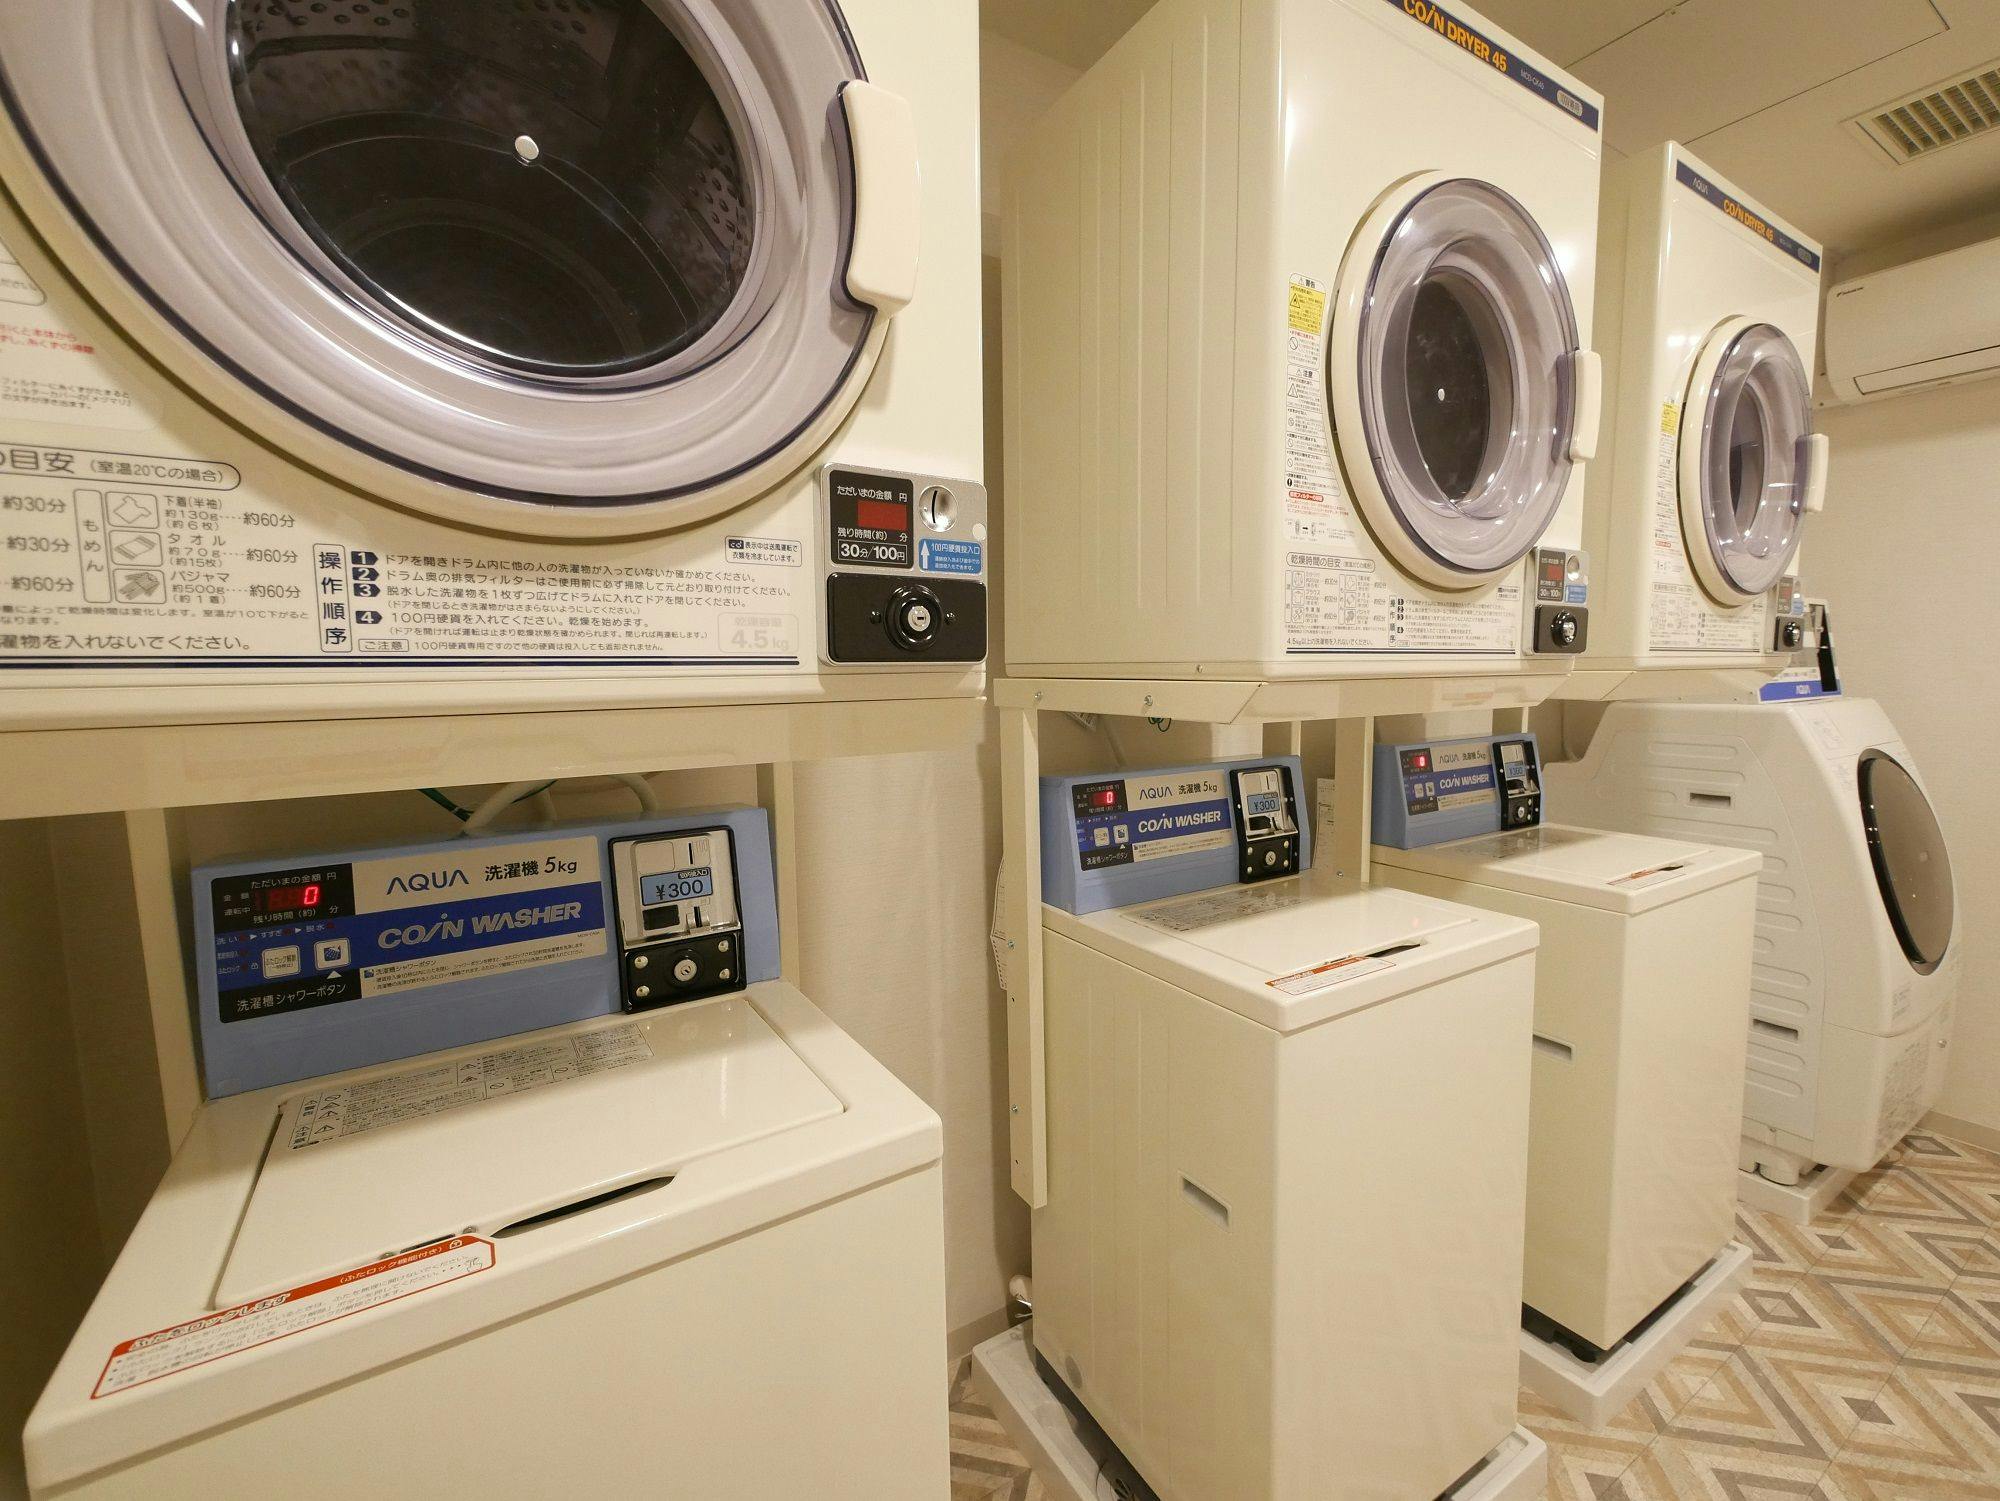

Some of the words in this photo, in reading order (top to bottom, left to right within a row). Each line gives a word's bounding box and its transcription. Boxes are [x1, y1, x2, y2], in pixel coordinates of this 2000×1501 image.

[1447, 20, 1490, 62] DRYER
[1492, 54, 1508, 73] 45
[1744, 213, 1766, 236] DRYER
[0, 449, 74, 474] 目安
[836, 485, 893, 502] ただいまの金額
[898, 492, 908, 503] 円
[3, 496, 67, 513] 約30分
[243, 512, 295, 528] 約60分
[837, 527, 888, 541] 残り時間(約)
[898, 533, 909, 543] 分
[7, 536, 70, 553] 約30分
[246, 548, 298, 563] 約60分
[358, 568, 371, 581] 2
[12, 576, 74, 592] 約60分
[250, 584, 301, 599] 約60分
[359, 584, 372, 597] 3
[318, 552, 347, 645] 操作順序
[360, 611, 374, 624] 4
[364, 641, 403, 650] ご注意
[1461, 774, 1490, 787] WASHER
[1106, 791, 1114, 803] 0
[1139, 786, 1173, 800] AQUA
[1203, 781, 1218, 793] 5kg
[1253, 799, 1276, 812] ¥300
[1175, 811, 1221, 828] WASHER
[251, 874, 321, 889] ただいまの金額
[326, 872, 337, 881] 円
[386, 869, 470, 895] AQUA
[485, 860, 539, 882] 洗濯機
[544, 856, 578, 875] 5kg
[304, 886, 319, 905] 0
[656, 880, 704, 901] ¥300
[328, 905, 339, 914] 分
[472, 901, 582, 935] WASHER
